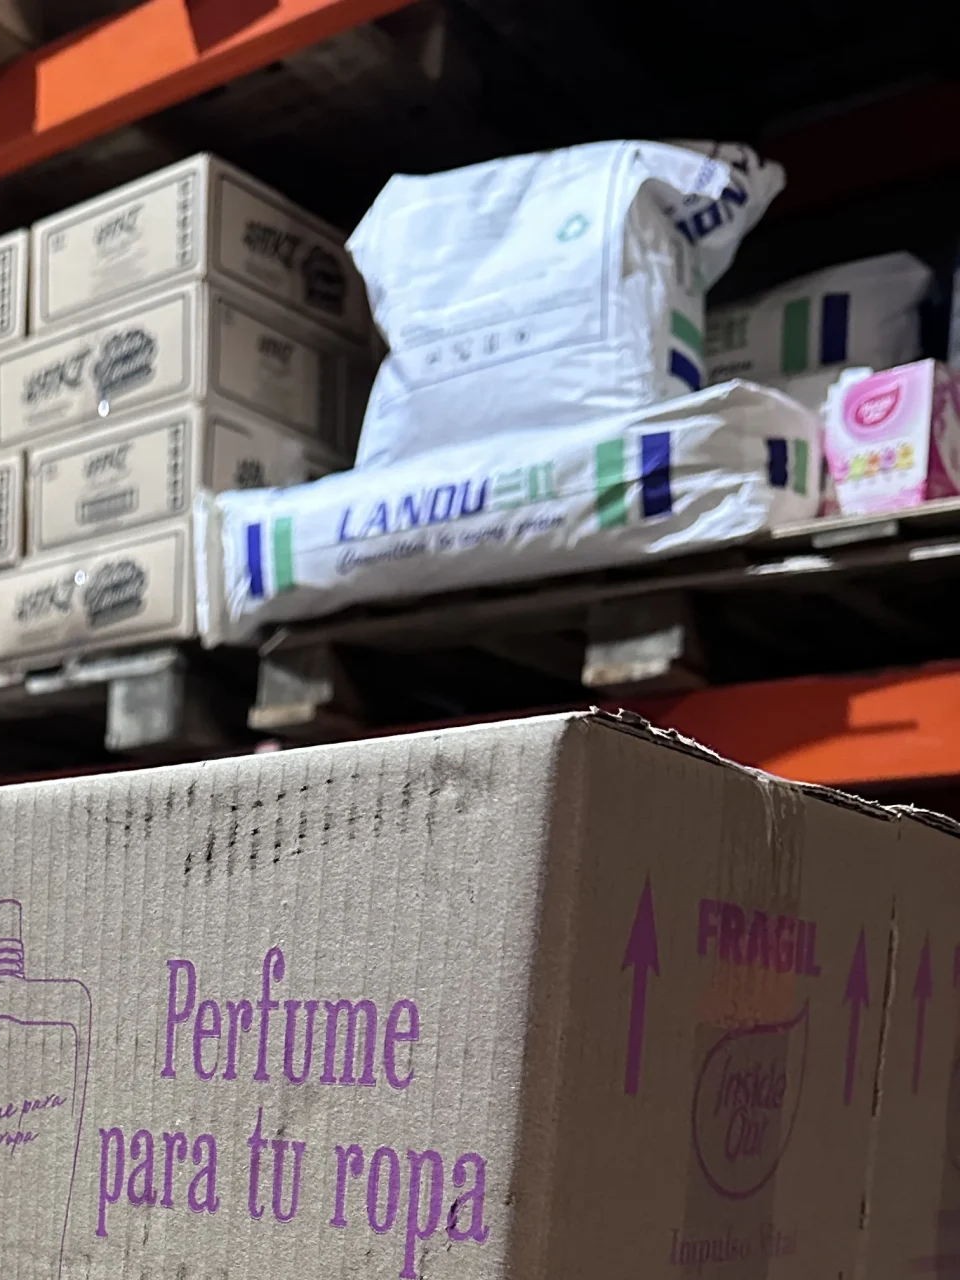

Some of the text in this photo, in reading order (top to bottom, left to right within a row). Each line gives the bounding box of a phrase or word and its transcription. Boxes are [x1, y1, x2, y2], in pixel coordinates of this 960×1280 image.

[697, 898, 821, 977] FRAGIL
[161, 947, 419, 1089] Perfume
[18, 1094, 67, 1128] para
[96, 1107, 489, 1279] para tu ropa
